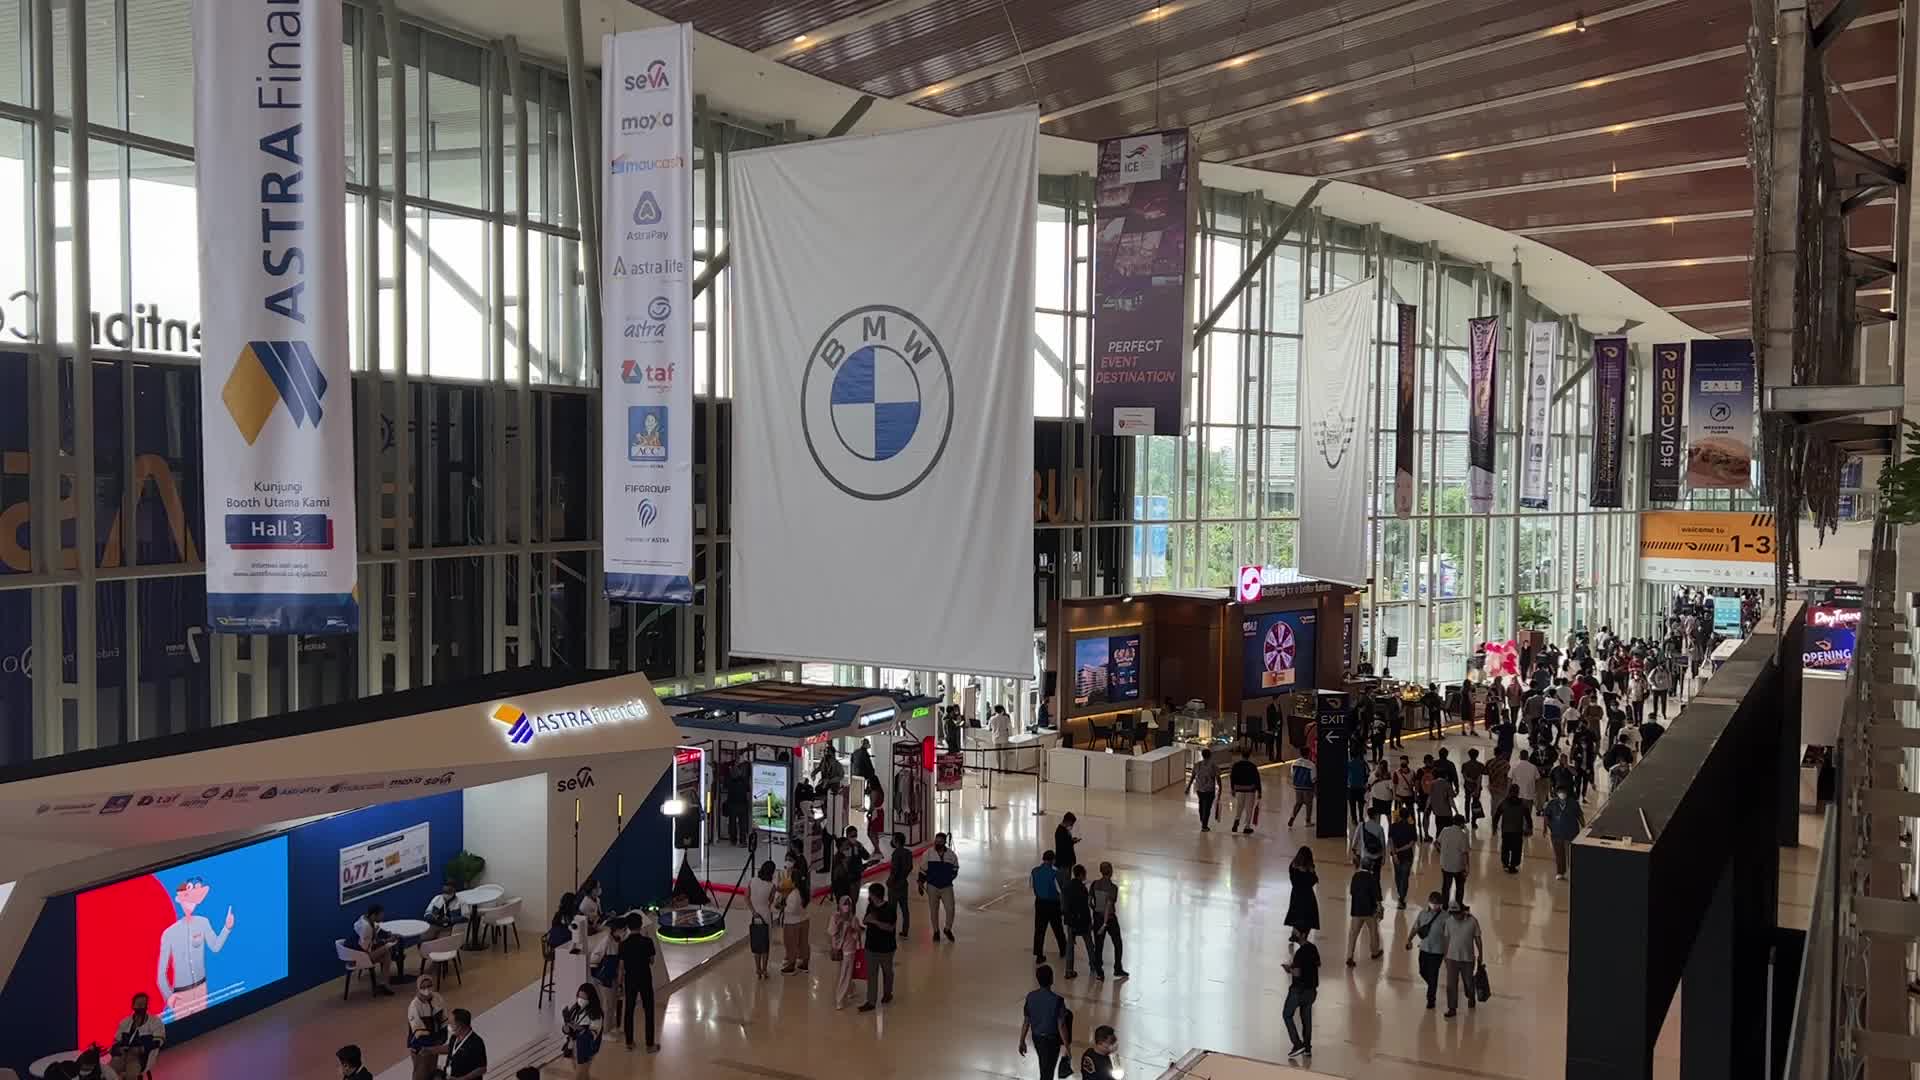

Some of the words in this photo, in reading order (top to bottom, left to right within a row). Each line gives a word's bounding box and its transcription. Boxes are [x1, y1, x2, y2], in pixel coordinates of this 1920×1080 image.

[259, 0, 301, 109] Fina
[622, 113, 673, 130] moxa
[1124, 161, 1140, 172] ICE
[260, 122, 305, 324] ASTRA
[626, 231, 670, 241] AstraPay
[624, 320, 666, 338] astra
[820, 315, 932, 370] BMW
[1108, 339, 1162, 353] PERFECT
[1101, 355, 1139, 369] EVENT
[645, 364, 675, 381] taf
[1096, 371, 1176, 384] DESTINATION
[254, 481, 303, 494] Kunjungi
[625, 485, 671, 493] FIFGROUP
[226, 498, 260, 507] Booth
[264, 498, 299, 508] Utama
[302, 497, 330, 507] Kami
[251, 520, 287, 537] Hall
[293, 521, 302, 537] 3
[1802, 649, 1852, 663] OPENING
[536, 709, 594, 733] ASTRA
[1321, 714, 1345, 724] EXIT
[344, 862, 368, 884] 0,77
